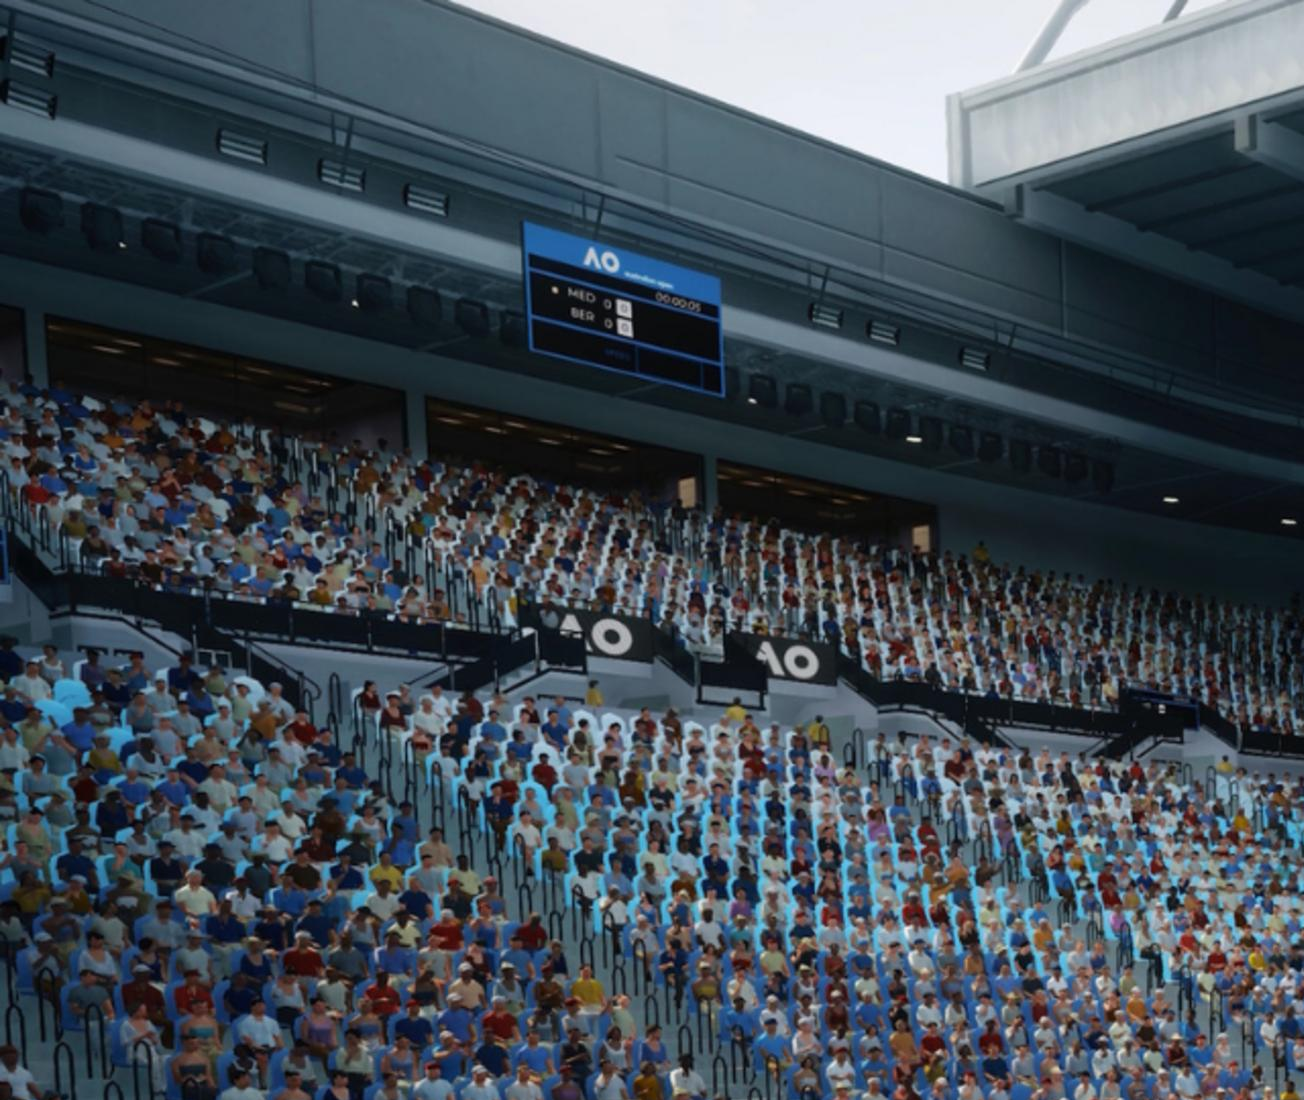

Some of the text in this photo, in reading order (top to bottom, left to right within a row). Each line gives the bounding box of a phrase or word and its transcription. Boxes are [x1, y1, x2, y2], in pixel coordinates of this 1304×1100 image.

[584, 247, 620, 273] AO
[568, 287, 596, 303] MED
[570, 307, 595, 322] BER
